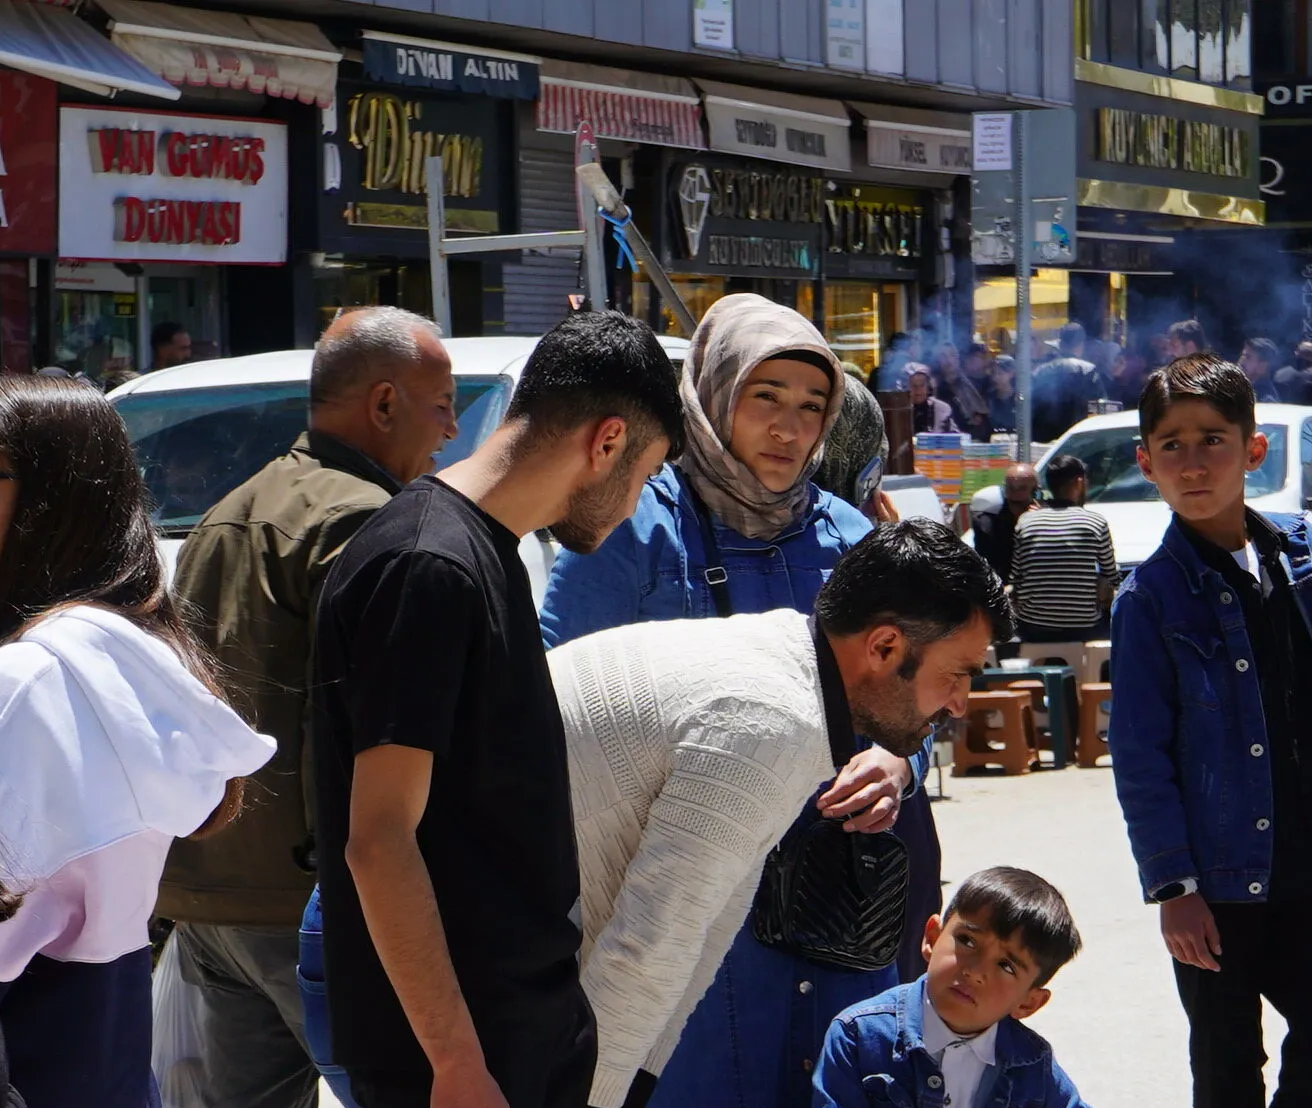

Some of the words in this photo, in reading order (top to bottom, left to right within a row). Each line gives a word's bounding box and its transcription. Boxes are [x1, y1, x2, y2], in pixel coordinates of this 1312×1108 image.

[464, 58, 519, 81] ALTIN
[94, 128, 155, 175] VAN
[163, 132, 265, 185] GÜMÜŞ
[121, 196, 241, 245] DÜNYASI
